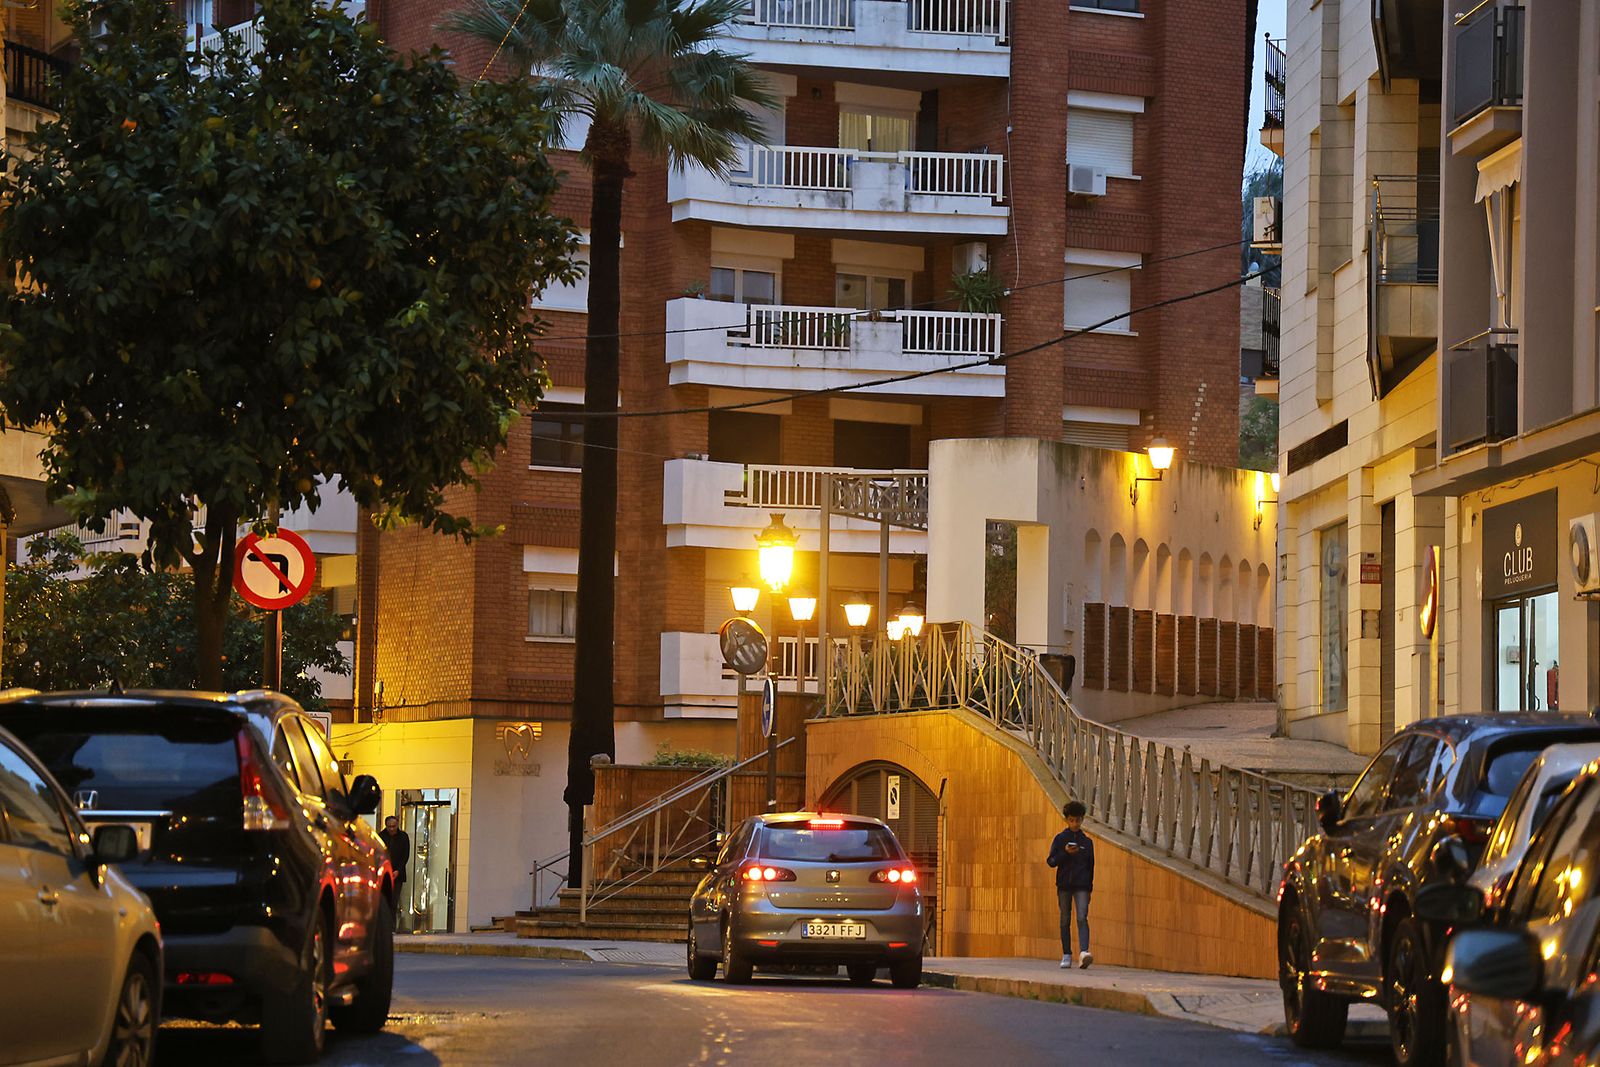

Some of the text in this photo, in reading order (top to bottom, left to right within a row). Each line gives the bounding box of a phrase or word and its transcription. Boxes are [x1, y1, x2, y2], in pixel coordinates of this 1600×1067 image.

[1503, 547, 1533, 577] CLUB
[808, 924, 862, 936] 3321 FFJ
